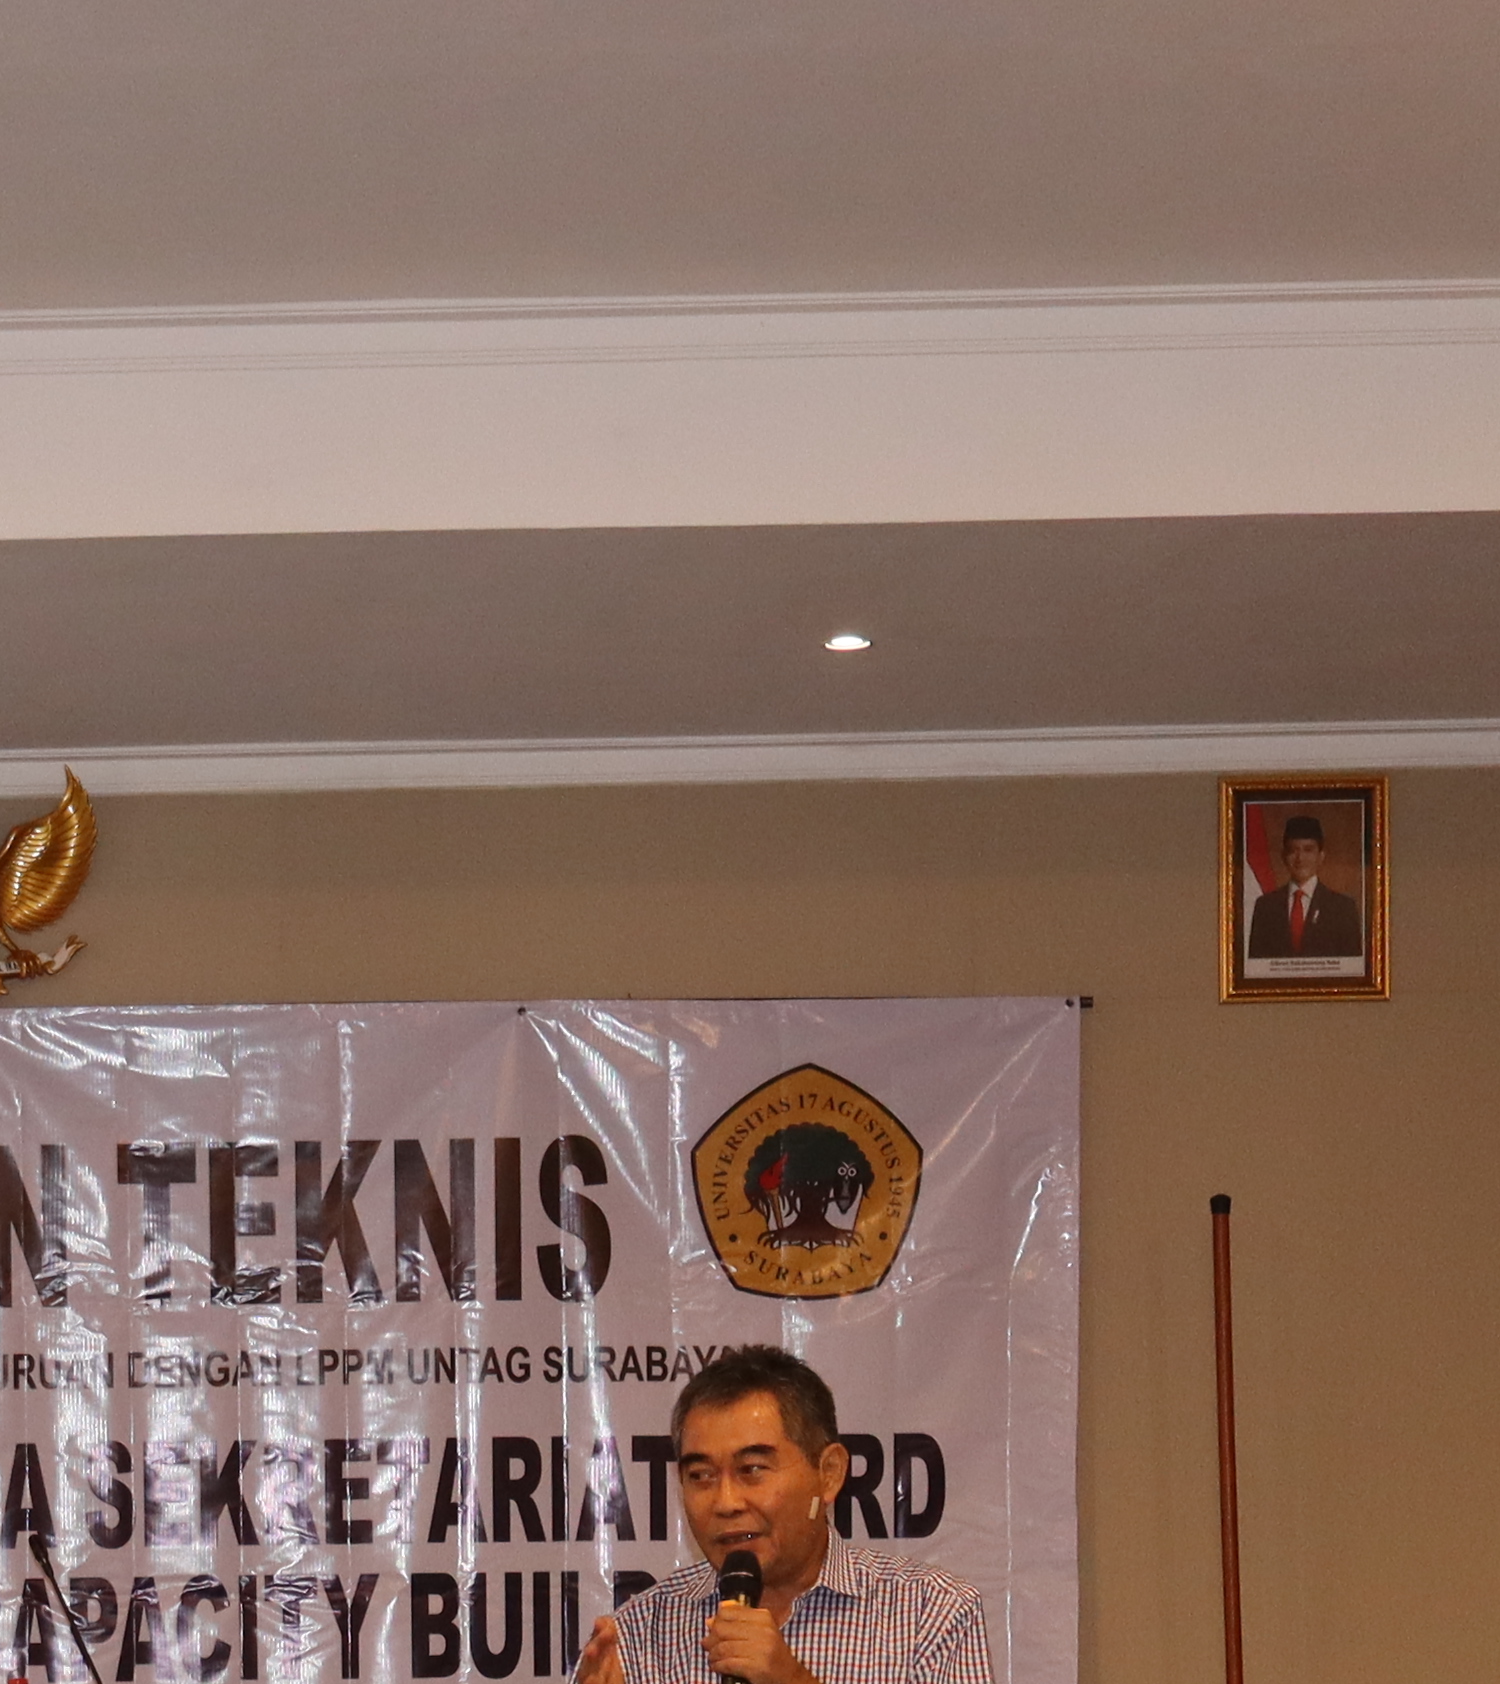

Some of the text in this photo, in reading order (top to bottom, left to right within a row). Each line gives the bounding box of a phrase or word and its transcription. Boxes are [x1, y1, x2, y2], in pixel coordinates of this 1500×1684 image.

[712, 1093, 904, 1220] UNIVERSITAS 17 AGUSTUS 1945
[116, 1134, 611, 1304] TEKNIS
[743, 1250, 872, 1285] SURABAYA
[128, 1349, 283, 1390] DENGAN
[406, 1346, 532, 1385] UNTAG
[89, 1434, 679, 1549] SEKRETARIAT
